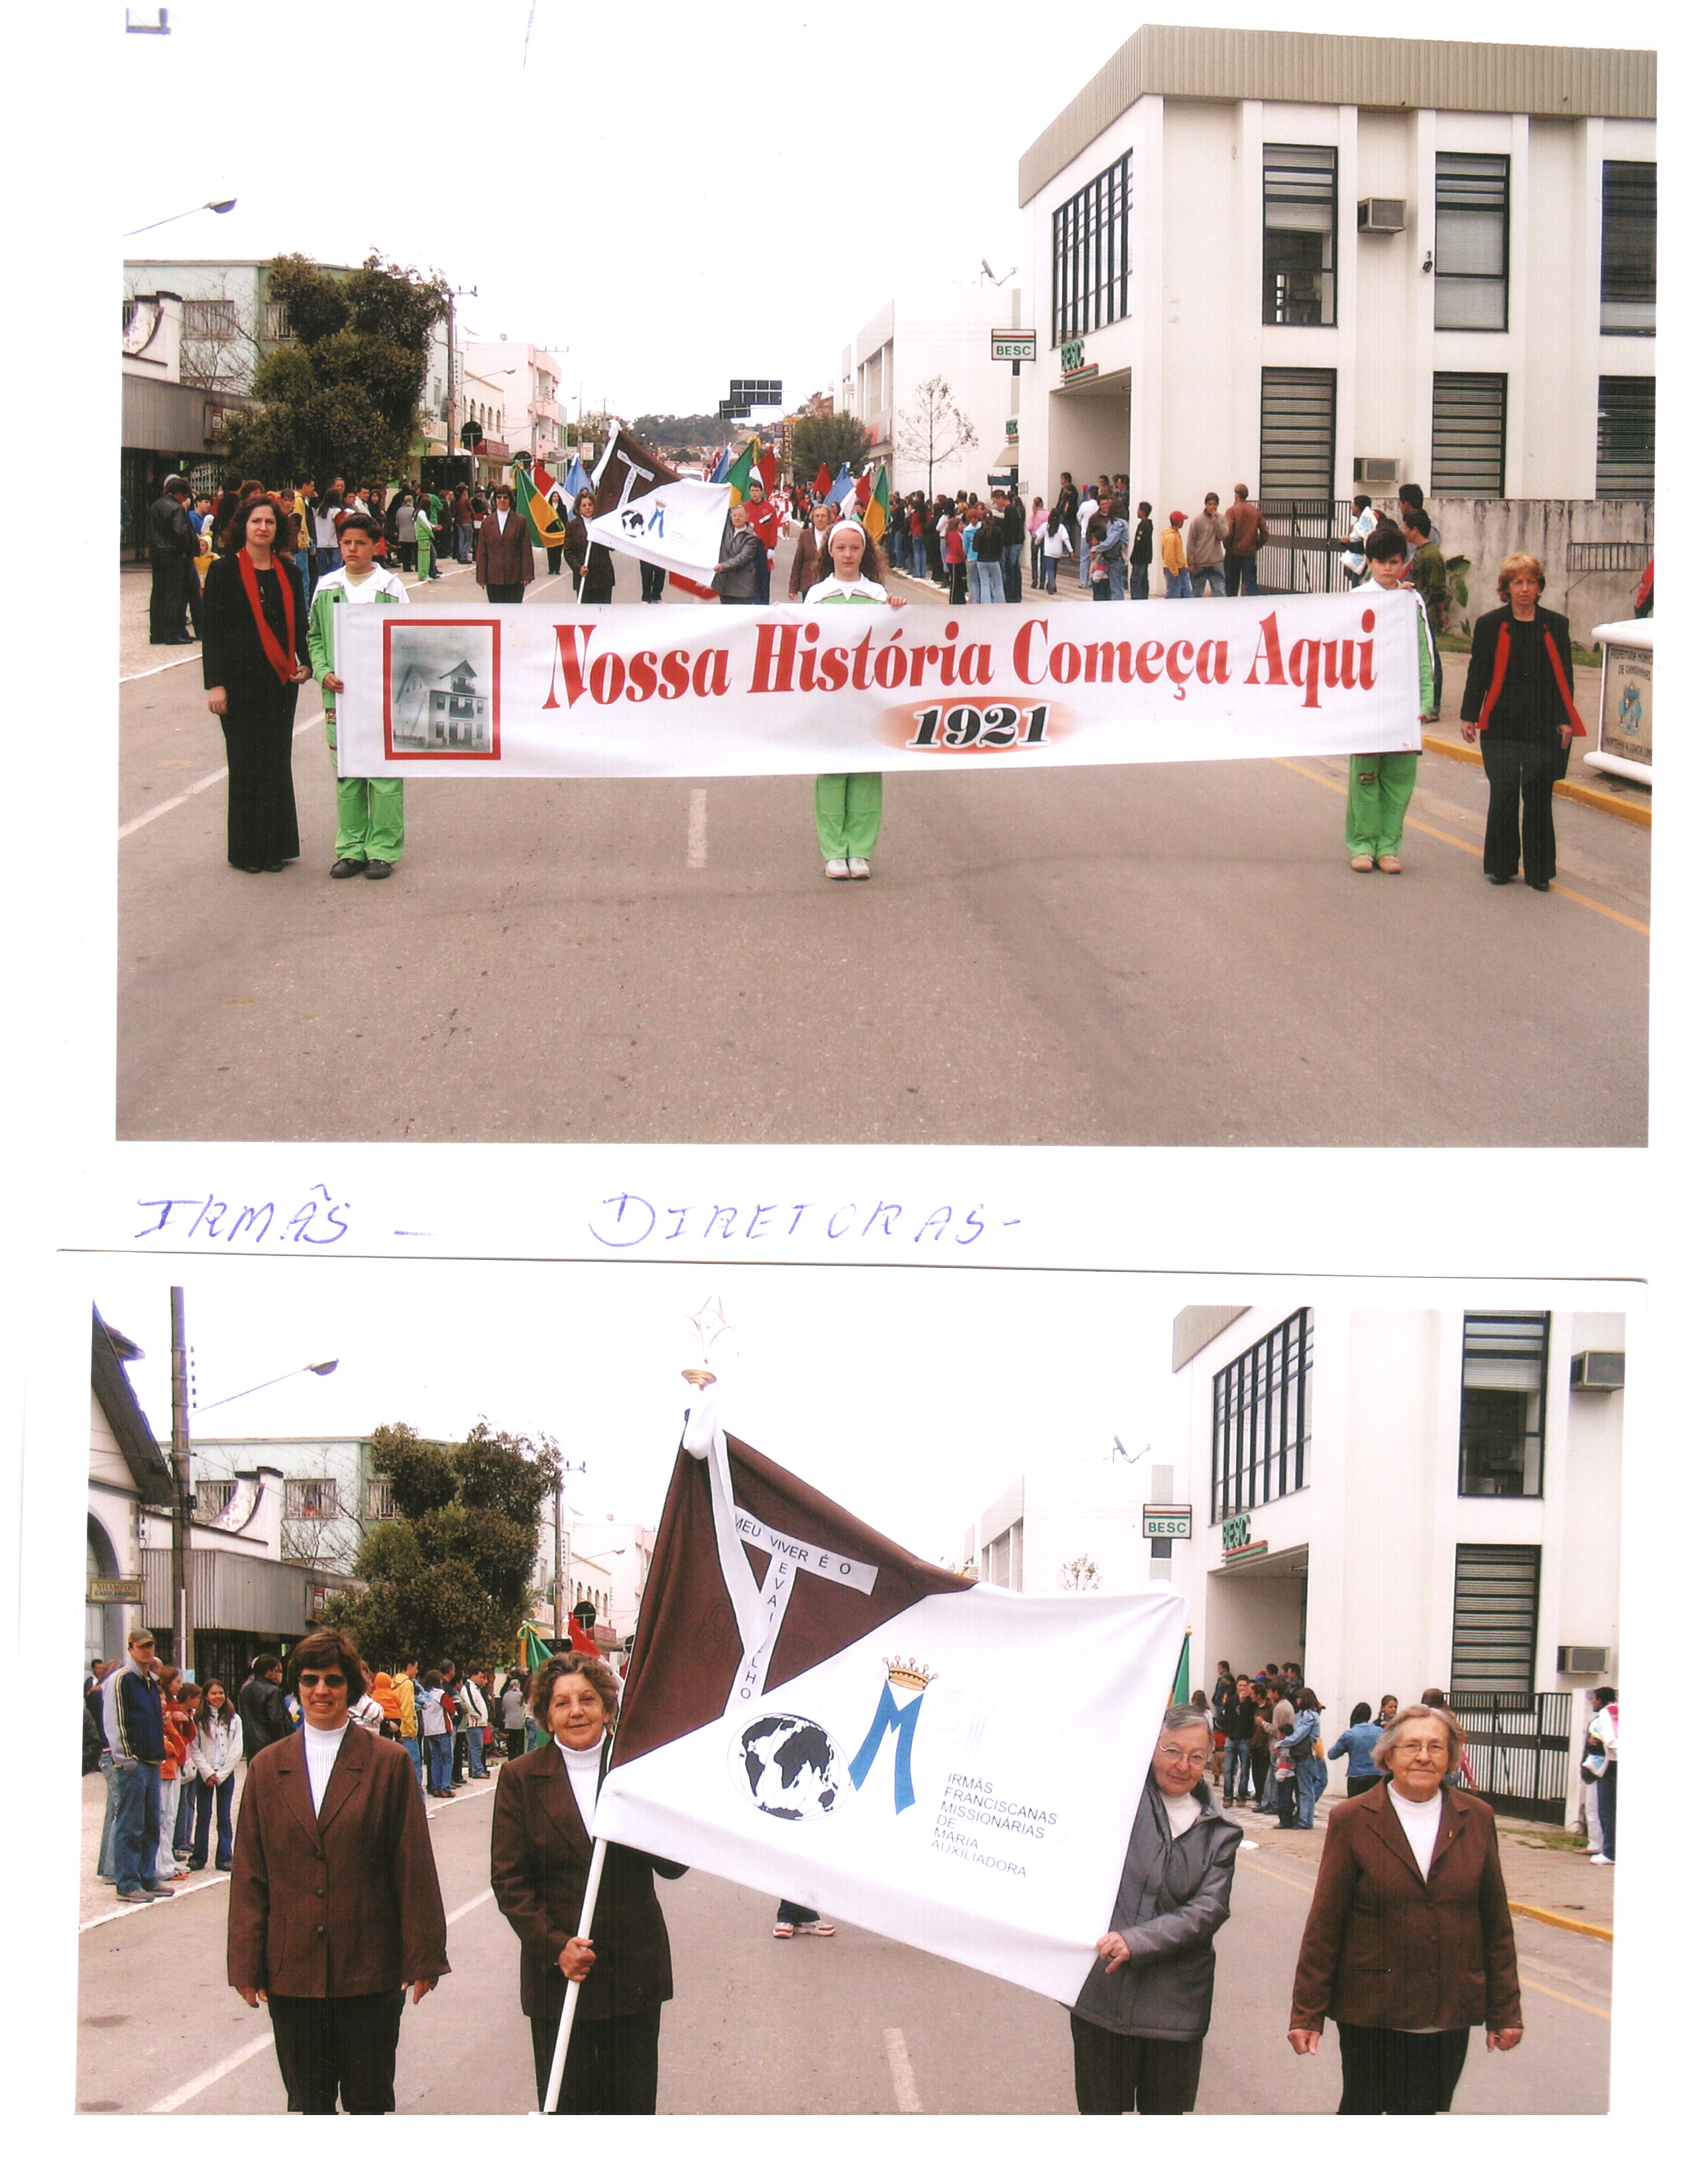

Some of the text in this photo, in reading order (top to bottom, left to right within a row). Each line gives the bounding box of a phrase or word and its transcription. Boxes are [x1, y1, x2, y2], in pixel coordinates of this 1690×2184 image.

[996, 345, 1031, 356] BESC
[1062, 339, 1085, 373] BESC
[541, 609, 1379, 710] Nossa História Começa Aqui
[907, 703, 1051, 748] 1921
[1149, 1522, 1186, 1533] BESC
[1223, 1514, 1251, 1550] BESC
[770, 1535, 809, 1562] VIVER
[818, 1554, 829, 1568] É
[840, 1562, 851, 1575] O
[948, 1772, 993, 1794] IRMÃS
[936, 1814, 957, 1829] DE
[940, 1800, 1045, 1839] MISSIONÁRIAS
[944, 1786, 1058, 1825] FRANCISCANAS
[934, 1827, 978, 1849] MARIA
[930, 1839, 1027, 1878] AUXILIADORA
